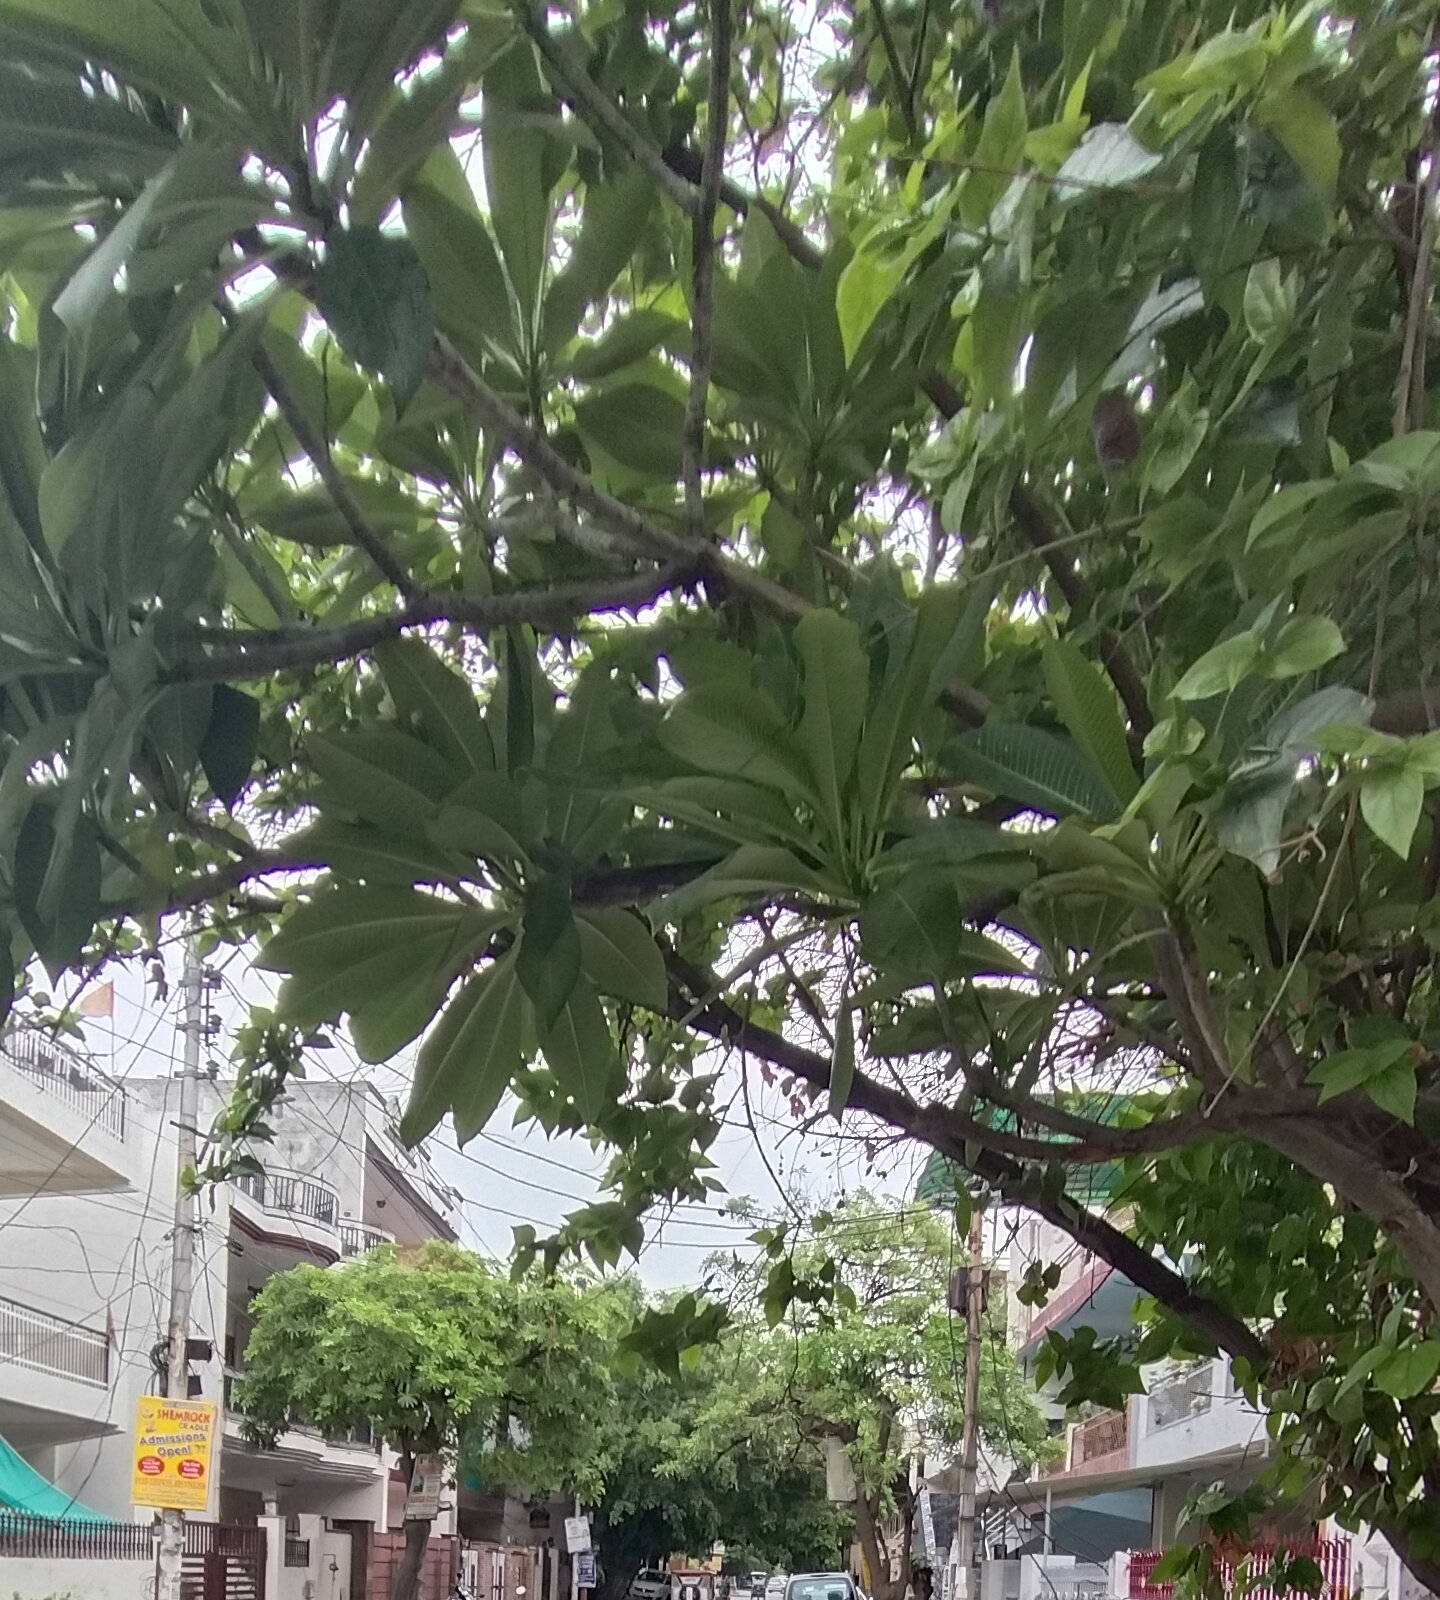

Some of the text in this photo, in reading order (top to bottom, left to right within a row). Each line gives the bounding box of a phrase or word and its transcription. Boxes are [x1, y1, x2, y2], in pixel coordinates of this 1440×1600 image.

[157, 1409, 210, 1423] SHEMROCK
[178, 1422, 209, 1432] CRADLE
[139, 1433, 206, 1446] Admissions
